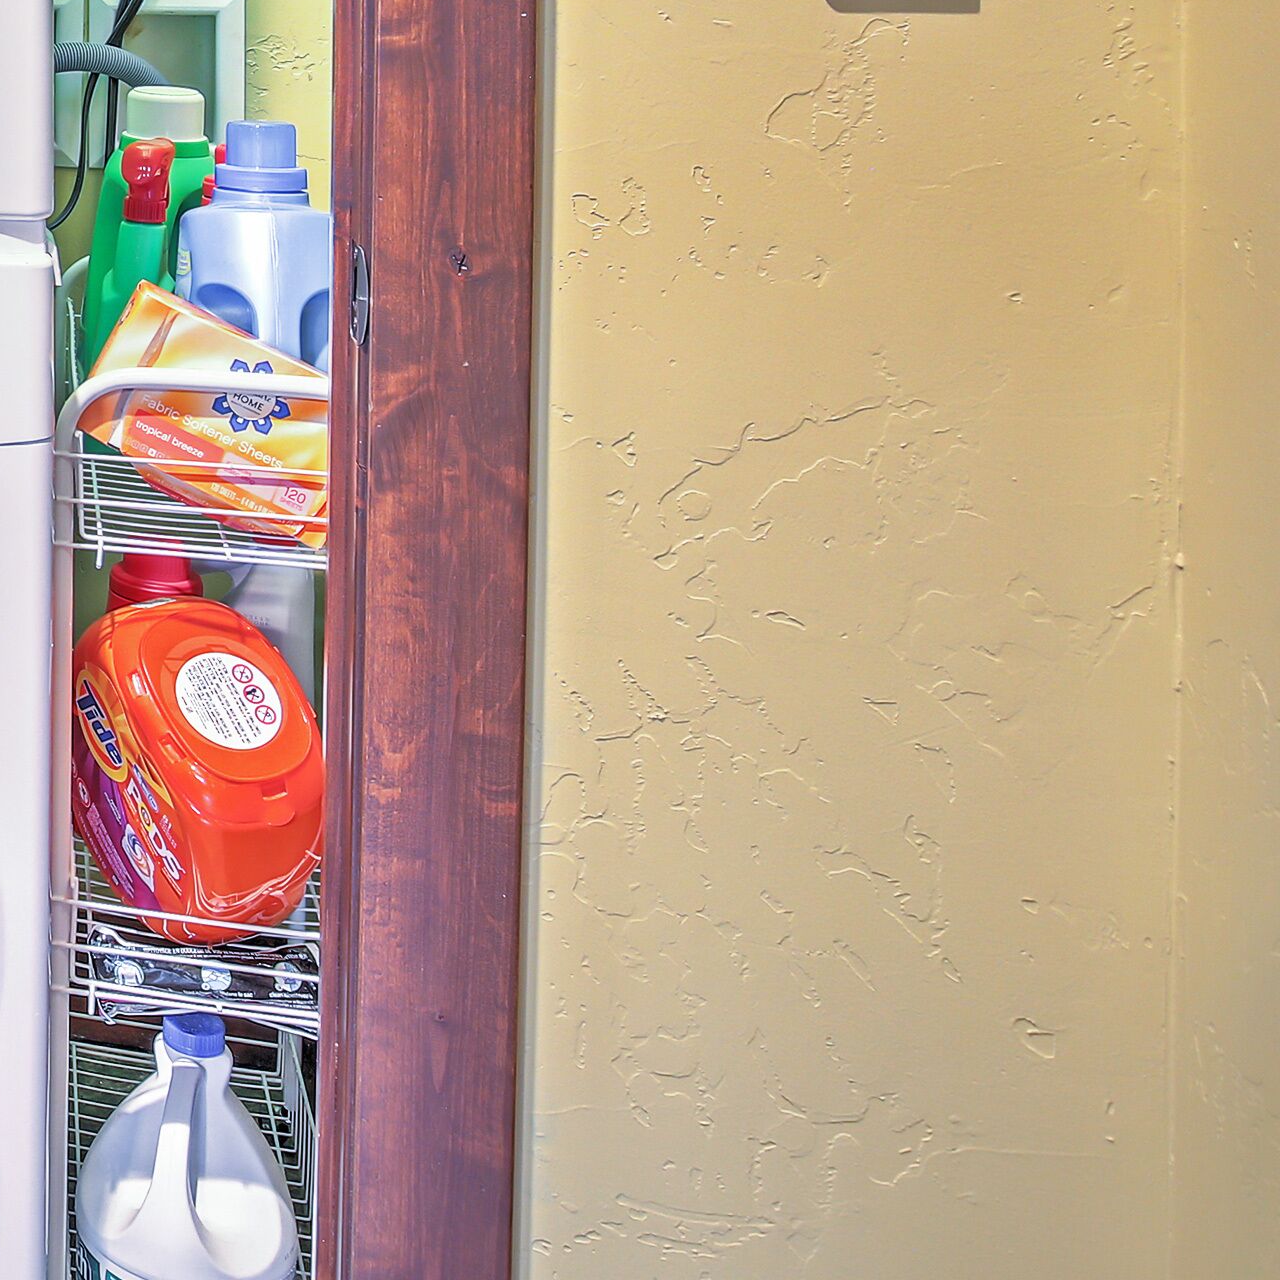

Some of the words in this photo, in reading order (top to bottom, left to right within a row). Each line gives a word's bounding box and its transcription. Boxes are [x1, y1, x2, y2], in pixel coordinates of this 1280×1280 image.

[233, 393, 264, 412] HOME
[135, 420, 171, 444] tropical
[171, 435, 205, 459] breeze
[142, 394, 180, 420] Fabric
[182, 414, 238, 447] Softener
[238, 441, 284, 469] Sheets
[283, 486, 307, 505] 120
[76, 679, 124, 767] Tide
[126, 777, 186, 881] PODS
